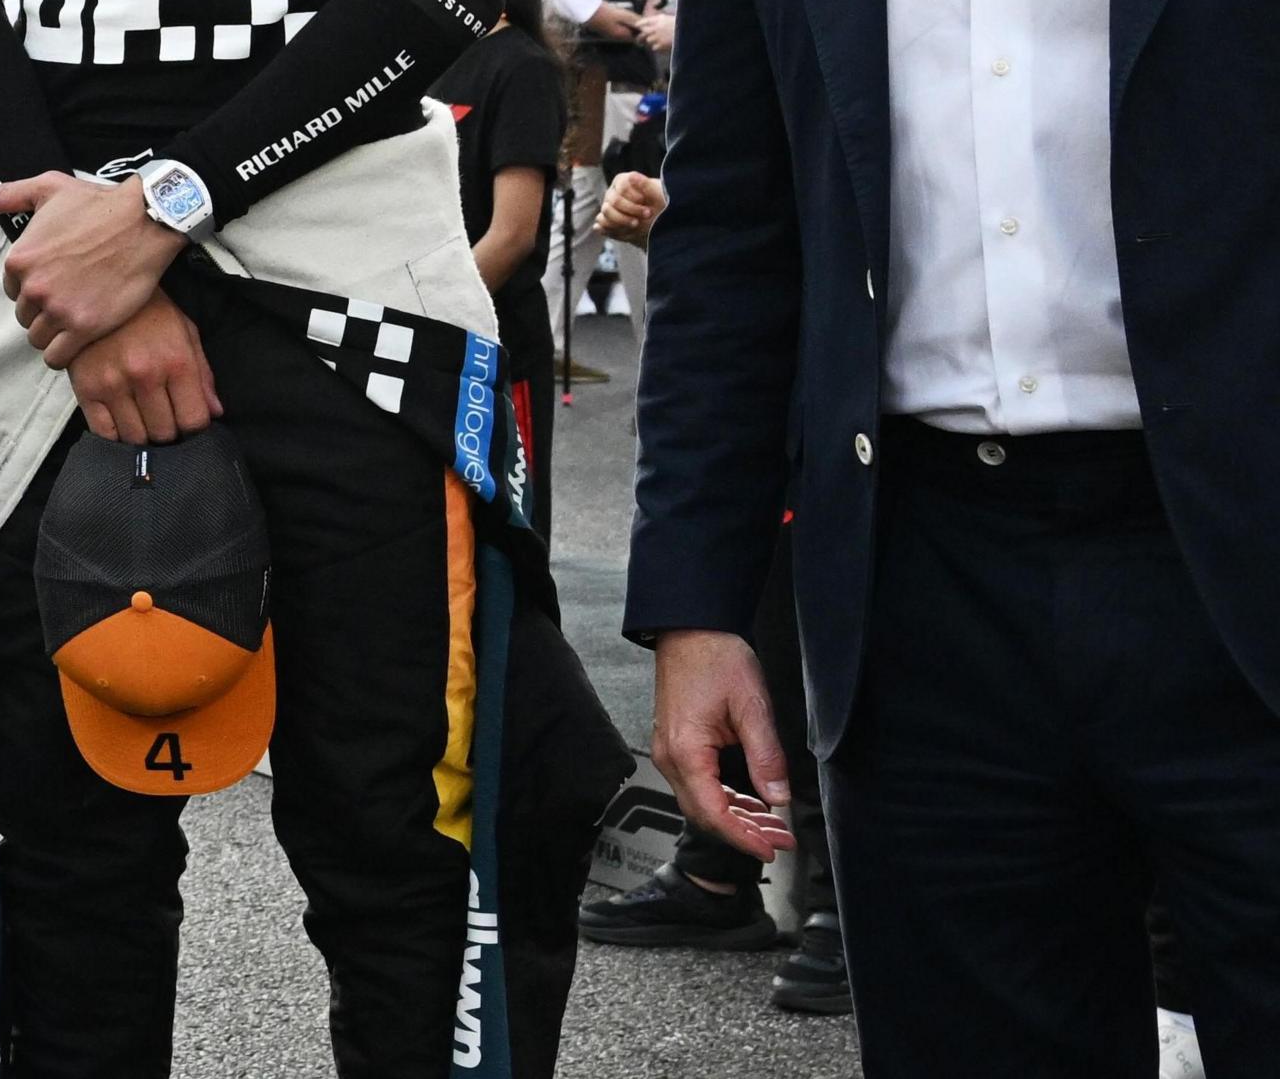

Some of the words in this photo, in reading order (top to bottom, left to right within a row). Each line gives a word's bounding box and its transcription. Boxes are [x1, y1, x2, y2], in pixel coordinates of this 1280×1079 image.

[235, 106, 343, 183] RICHARD
[343, 49, 416, 114] MILLE
[142, 731, 193, 781] 4
